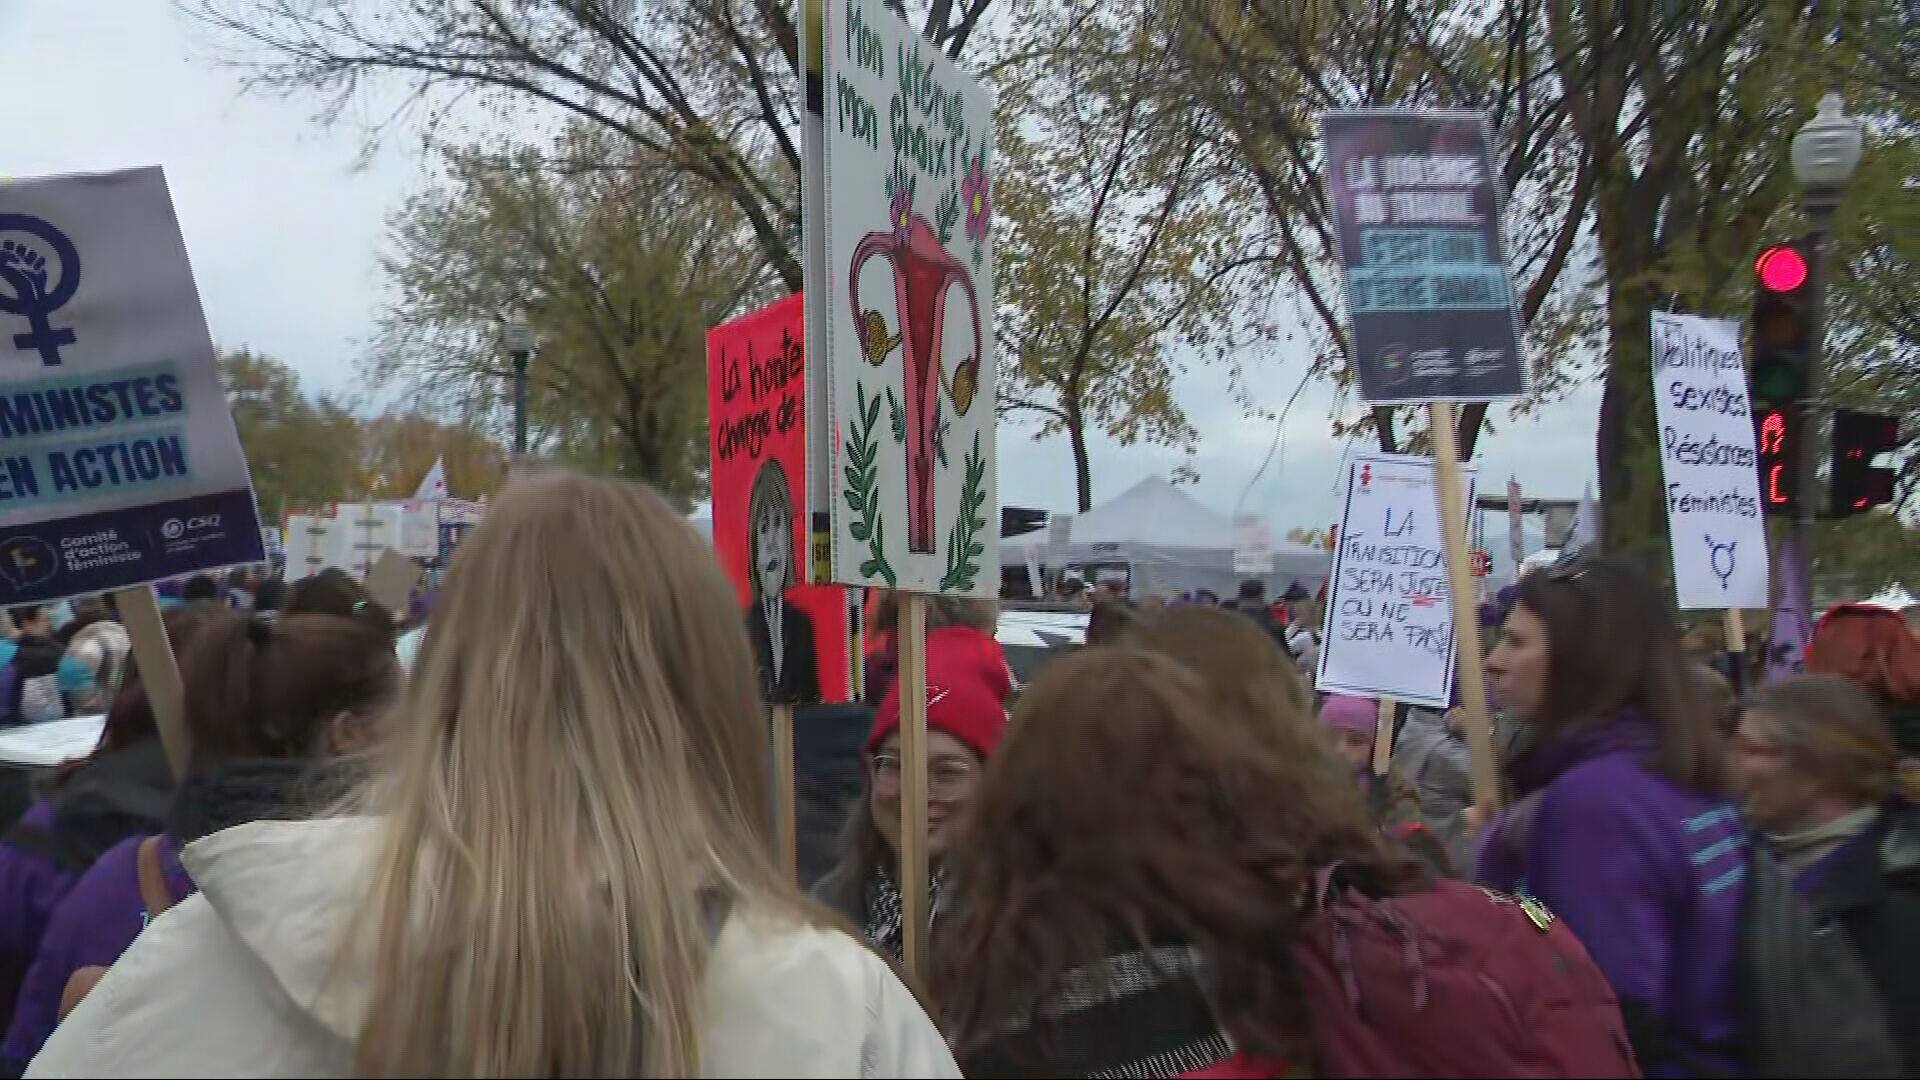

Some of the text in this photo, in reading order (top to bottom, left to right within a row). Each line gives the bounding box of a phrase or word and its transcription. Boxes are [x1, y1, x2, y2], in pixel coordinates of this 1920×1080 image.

[846, 0, 884, 79] Mon
[836, 70, 879, 152] mon
[1345, 151, 1486, 187] LA VIOLENCE
[721, 328, 803, 402] La honte
[776, 391, 797, 433] de
[48, 435, 188, 494] ACTION
[1668, 482, 1758, 519] Féministes
[186, 513, 221, 531] CSQ
[1384, 508, 1414, 537] LA
[64, 541, 129, 561] d'action
[66, 551, 142, 573] féministe
[1341, 568, 1394, 595] SERA
[1341, 598, 1410, 623] OU NE
[1340, 621, 1394, 642] SERA
